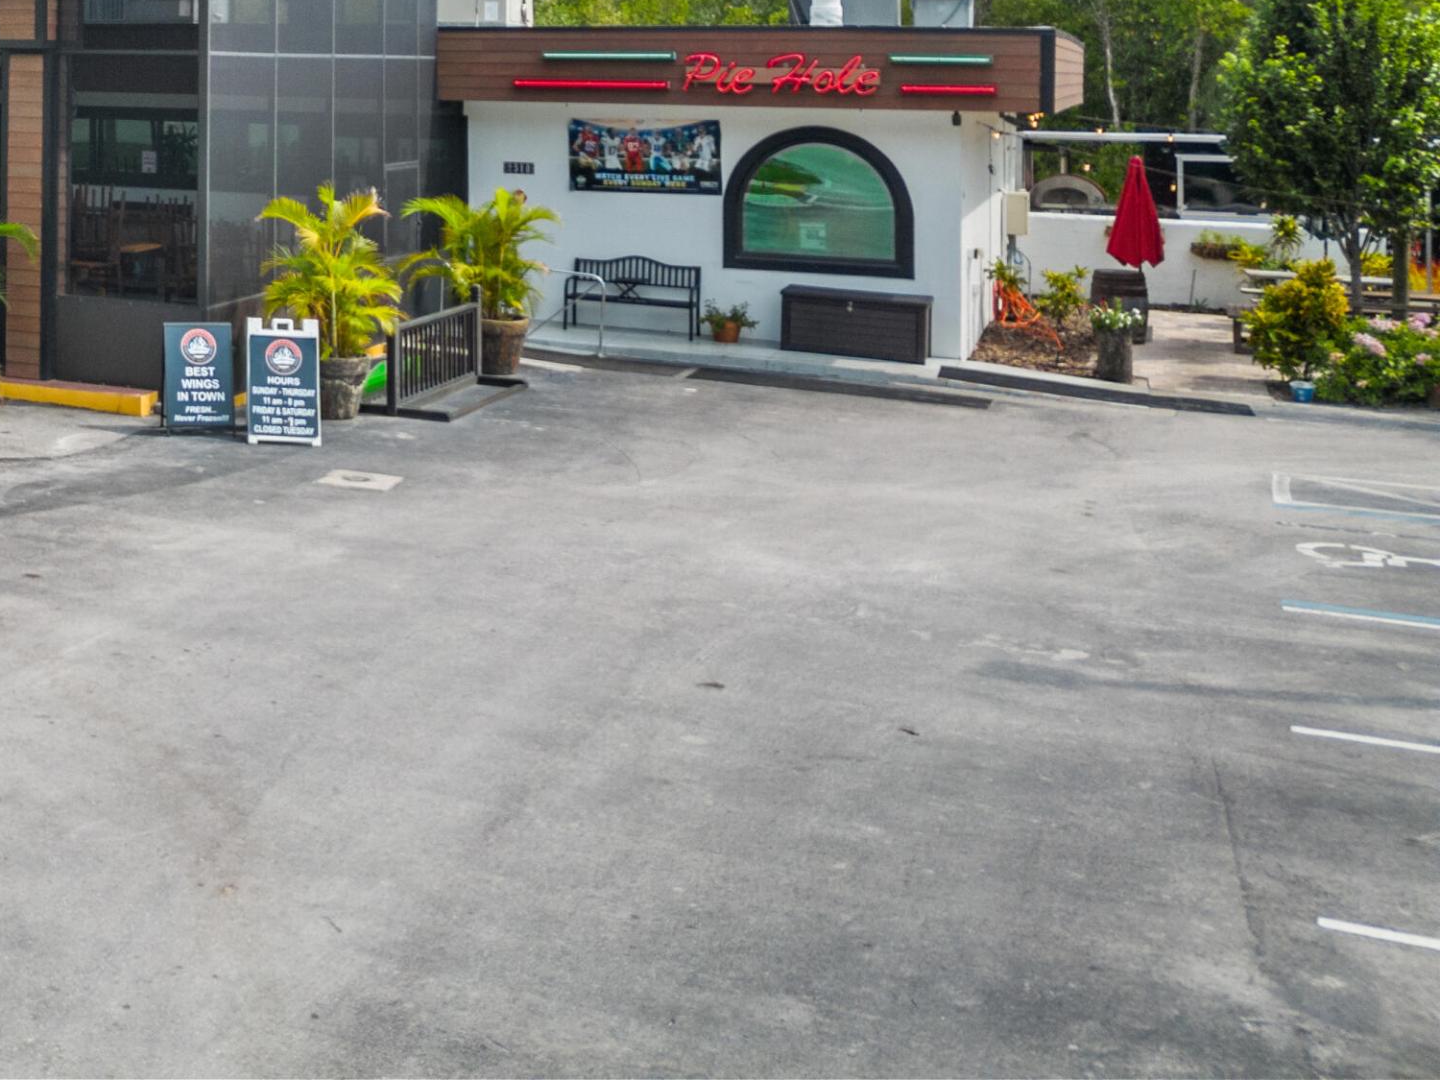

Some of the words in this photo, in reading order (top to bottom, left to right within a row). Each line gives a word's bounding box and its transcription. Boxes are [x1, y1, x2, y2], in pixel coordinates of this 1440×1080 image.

[682, 52, 756, 94] Pie
[767, 52, 881, 95] Hole
[185, 366, 216, 377] BEST
[181, 379, 220, 389] WINGS
[267, 376, 301, 386] HOURS
[177, 391, 189, 401] IN
[191, 391, 225, 401] TOWN
[252, 386, 278, 395] SUNDAY
[282, 387, 315, 397] THURSDAY
[263, 396, 271, 405] 11
[293, 399, 306, 408] pm
[252, 405, 276, 415] FRIDAY
[282, 407, 315, 417] SATURDAY
[174, 414, 196, 422] Never
[262, 415, 270, 424] 11
[271, 417, 283, 425] am
[294, 418, 307, 427] pm
[254, 424, 282, 434] CLOSED
[283, 425, 315, 436] TUESDAY
